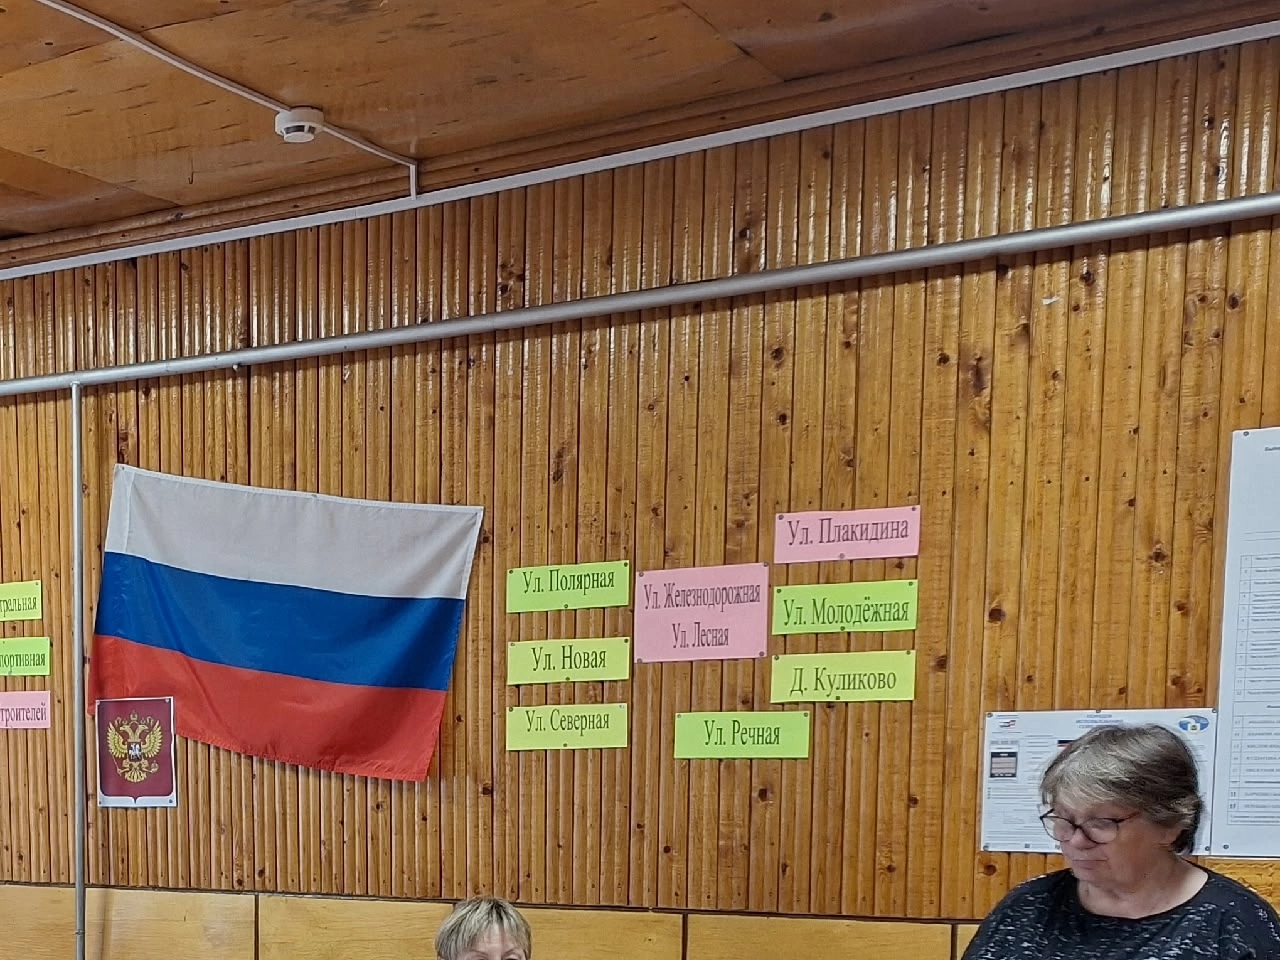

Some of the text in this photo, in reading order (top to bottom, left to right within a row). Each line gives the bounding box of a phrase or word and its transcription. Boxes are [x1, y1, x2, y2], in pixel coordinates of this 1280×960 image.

[787, 518, 909, 546] Ул. Плакидина
[522, 569, 615, 596] Ул. Полярная
[643, 582, 761, 612] Ул. Железнодорожная
[783, 596, 910, 626] Ул. Молодёжная
[672, 621, 729, 649] Ул. Лесная
[531, 644, 607, 671] Ул. Новая
[789, 666, 897, 698] Д. Куликово
[525, 708, 610, 737] Ул. Северная
[703, 719, 781, 746] Ул. Речная
